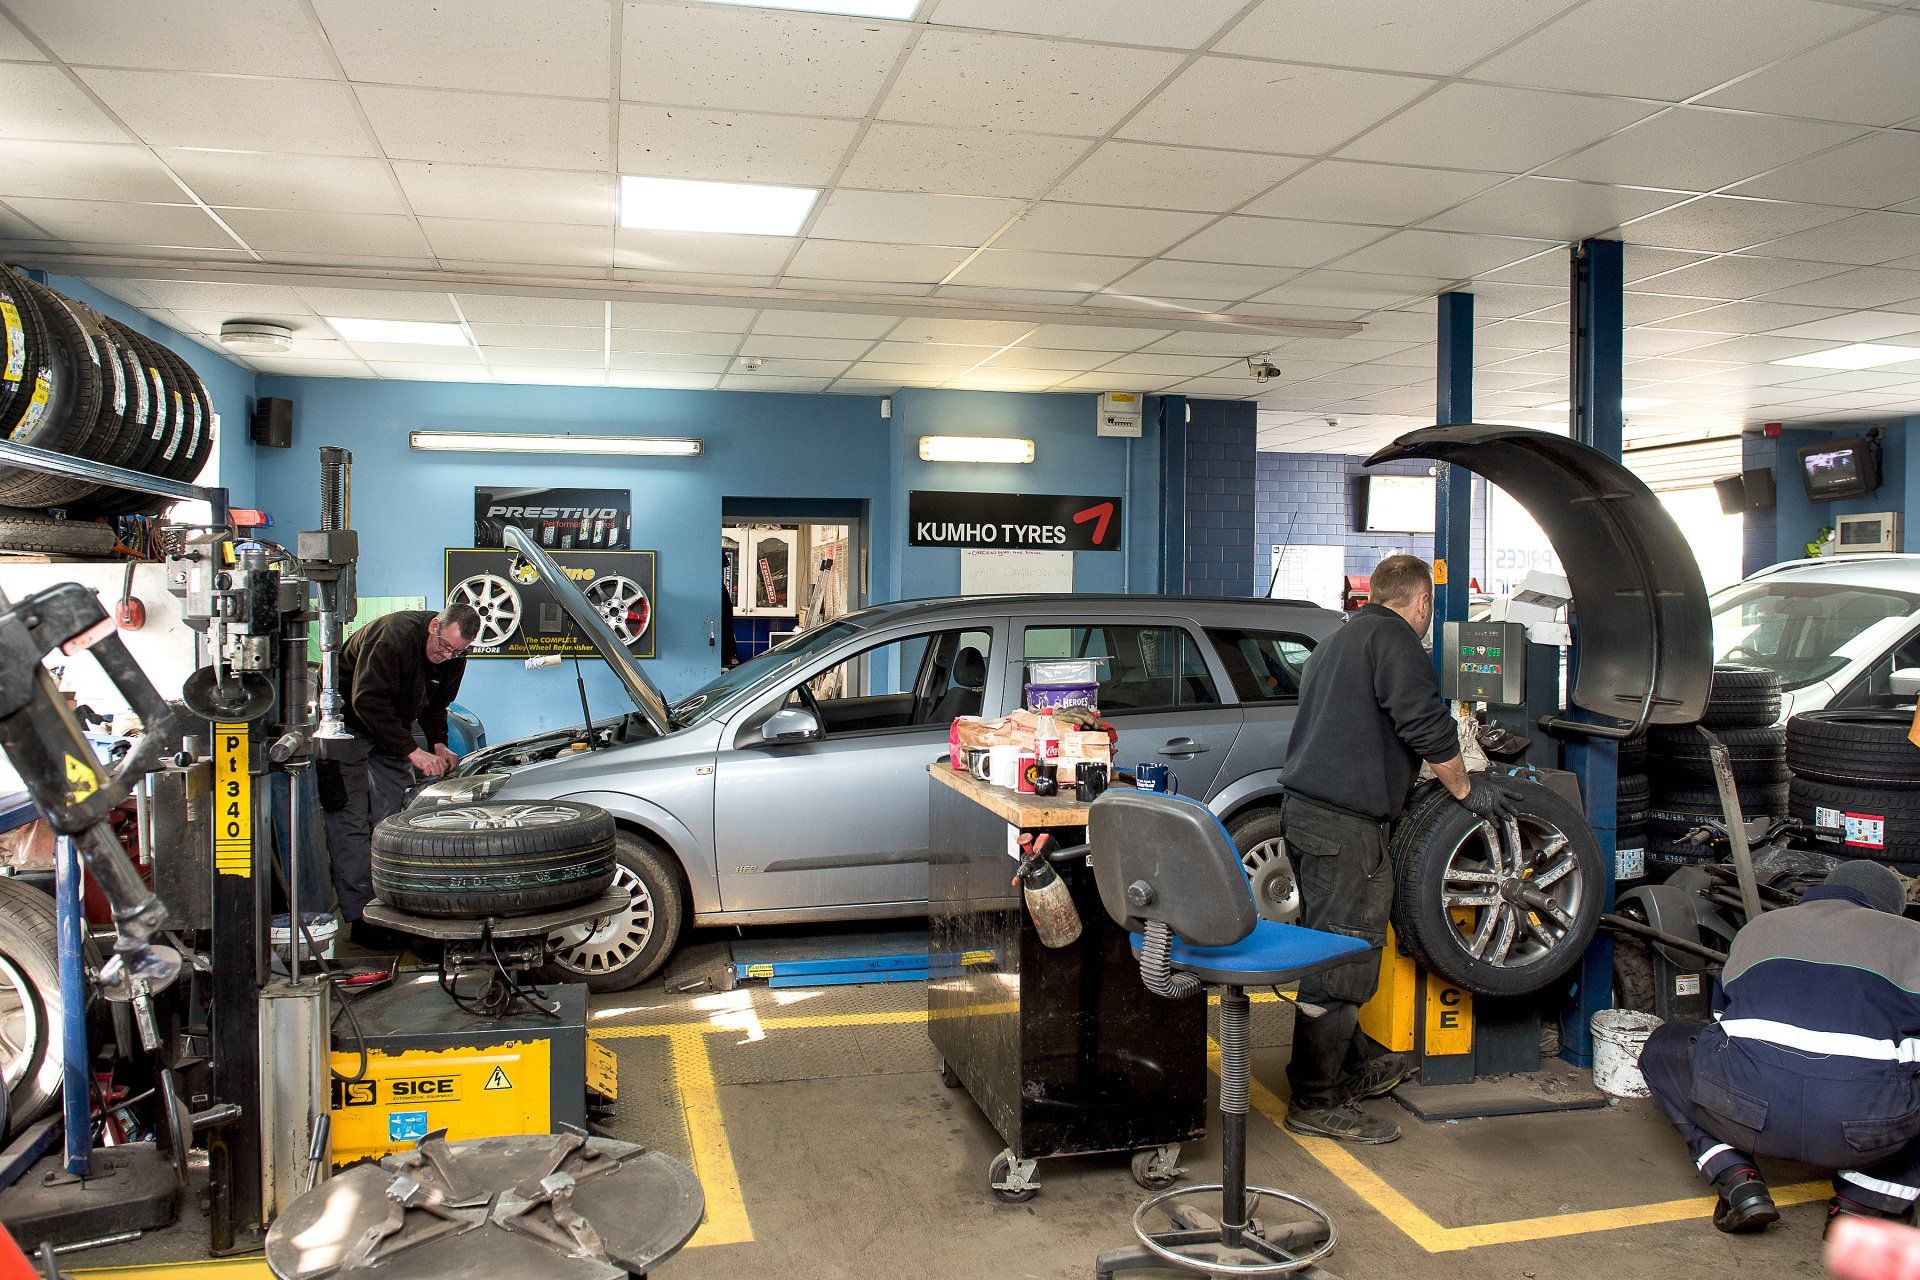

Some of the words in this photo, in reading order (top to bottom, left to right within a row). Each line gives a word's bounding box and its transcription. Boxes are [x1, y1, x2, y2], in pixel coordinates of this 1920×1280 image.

[917, 522, 998, 543] KUMHO
[1001, 524, 1067, 544] TYRES
[1063, 697, 1088, 707] HEROES
[392, 1079, 454, 1095] SICE
